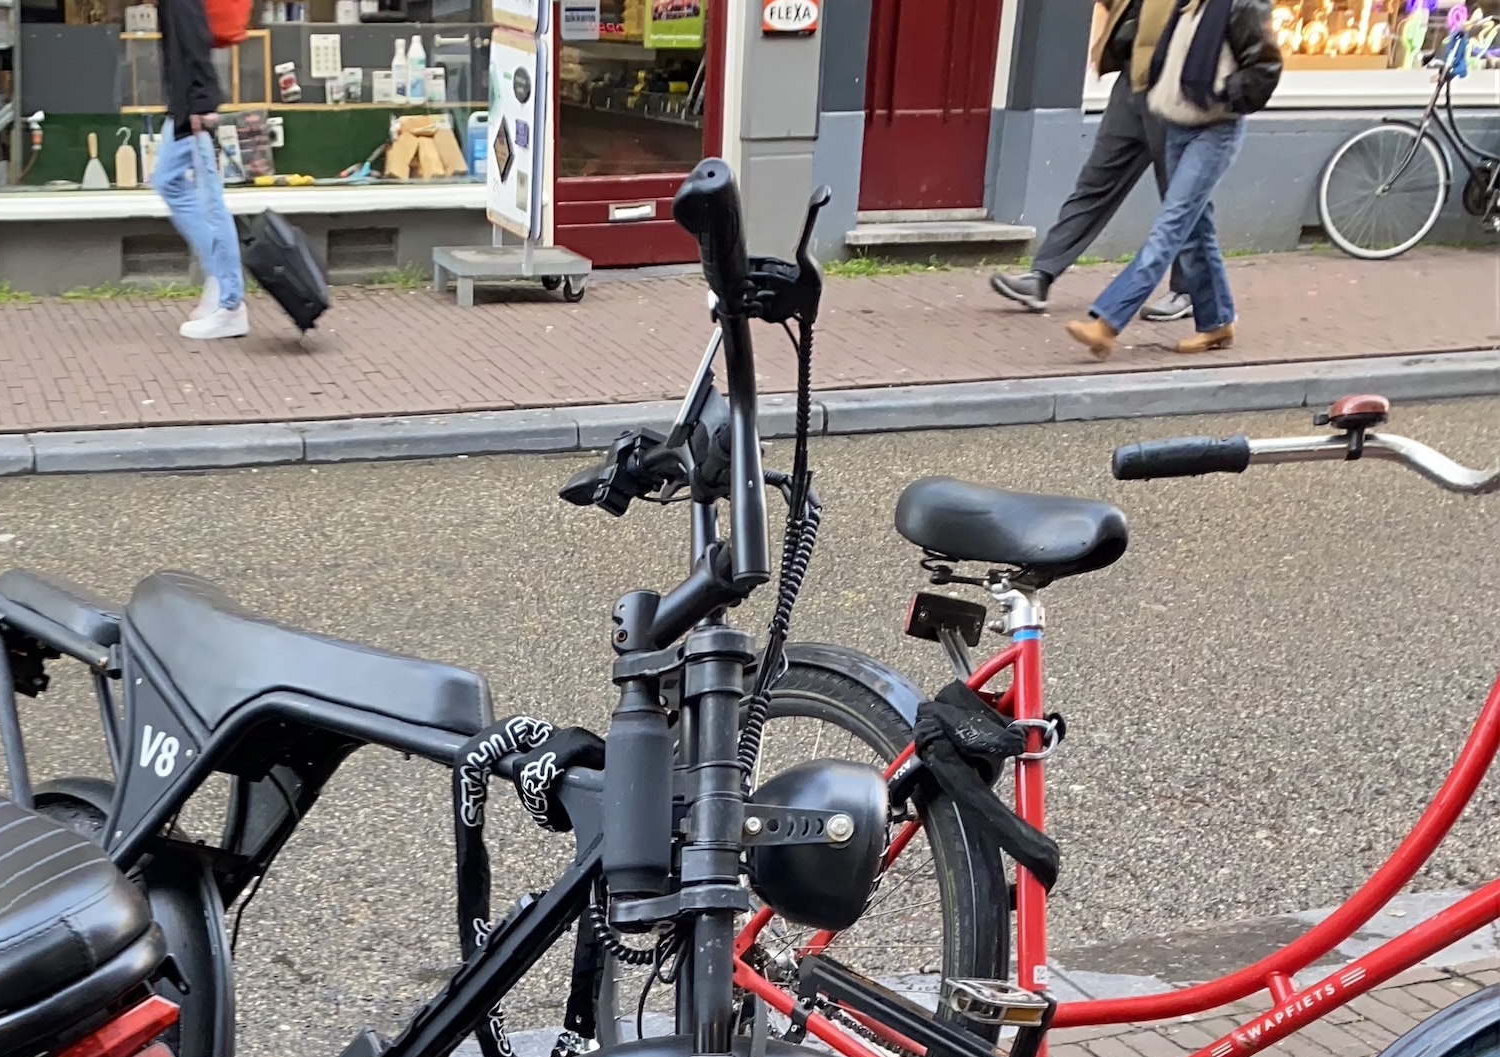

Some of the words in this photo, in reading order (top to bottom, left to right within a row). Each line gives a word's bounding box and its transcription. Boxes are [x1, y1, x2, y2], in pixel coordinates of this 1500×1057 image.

[770, 2, 812, 22] FLEXA
[139, 724, 180, 777] V8
[1236, 983, 1336, 1044] SWAPFIETS
